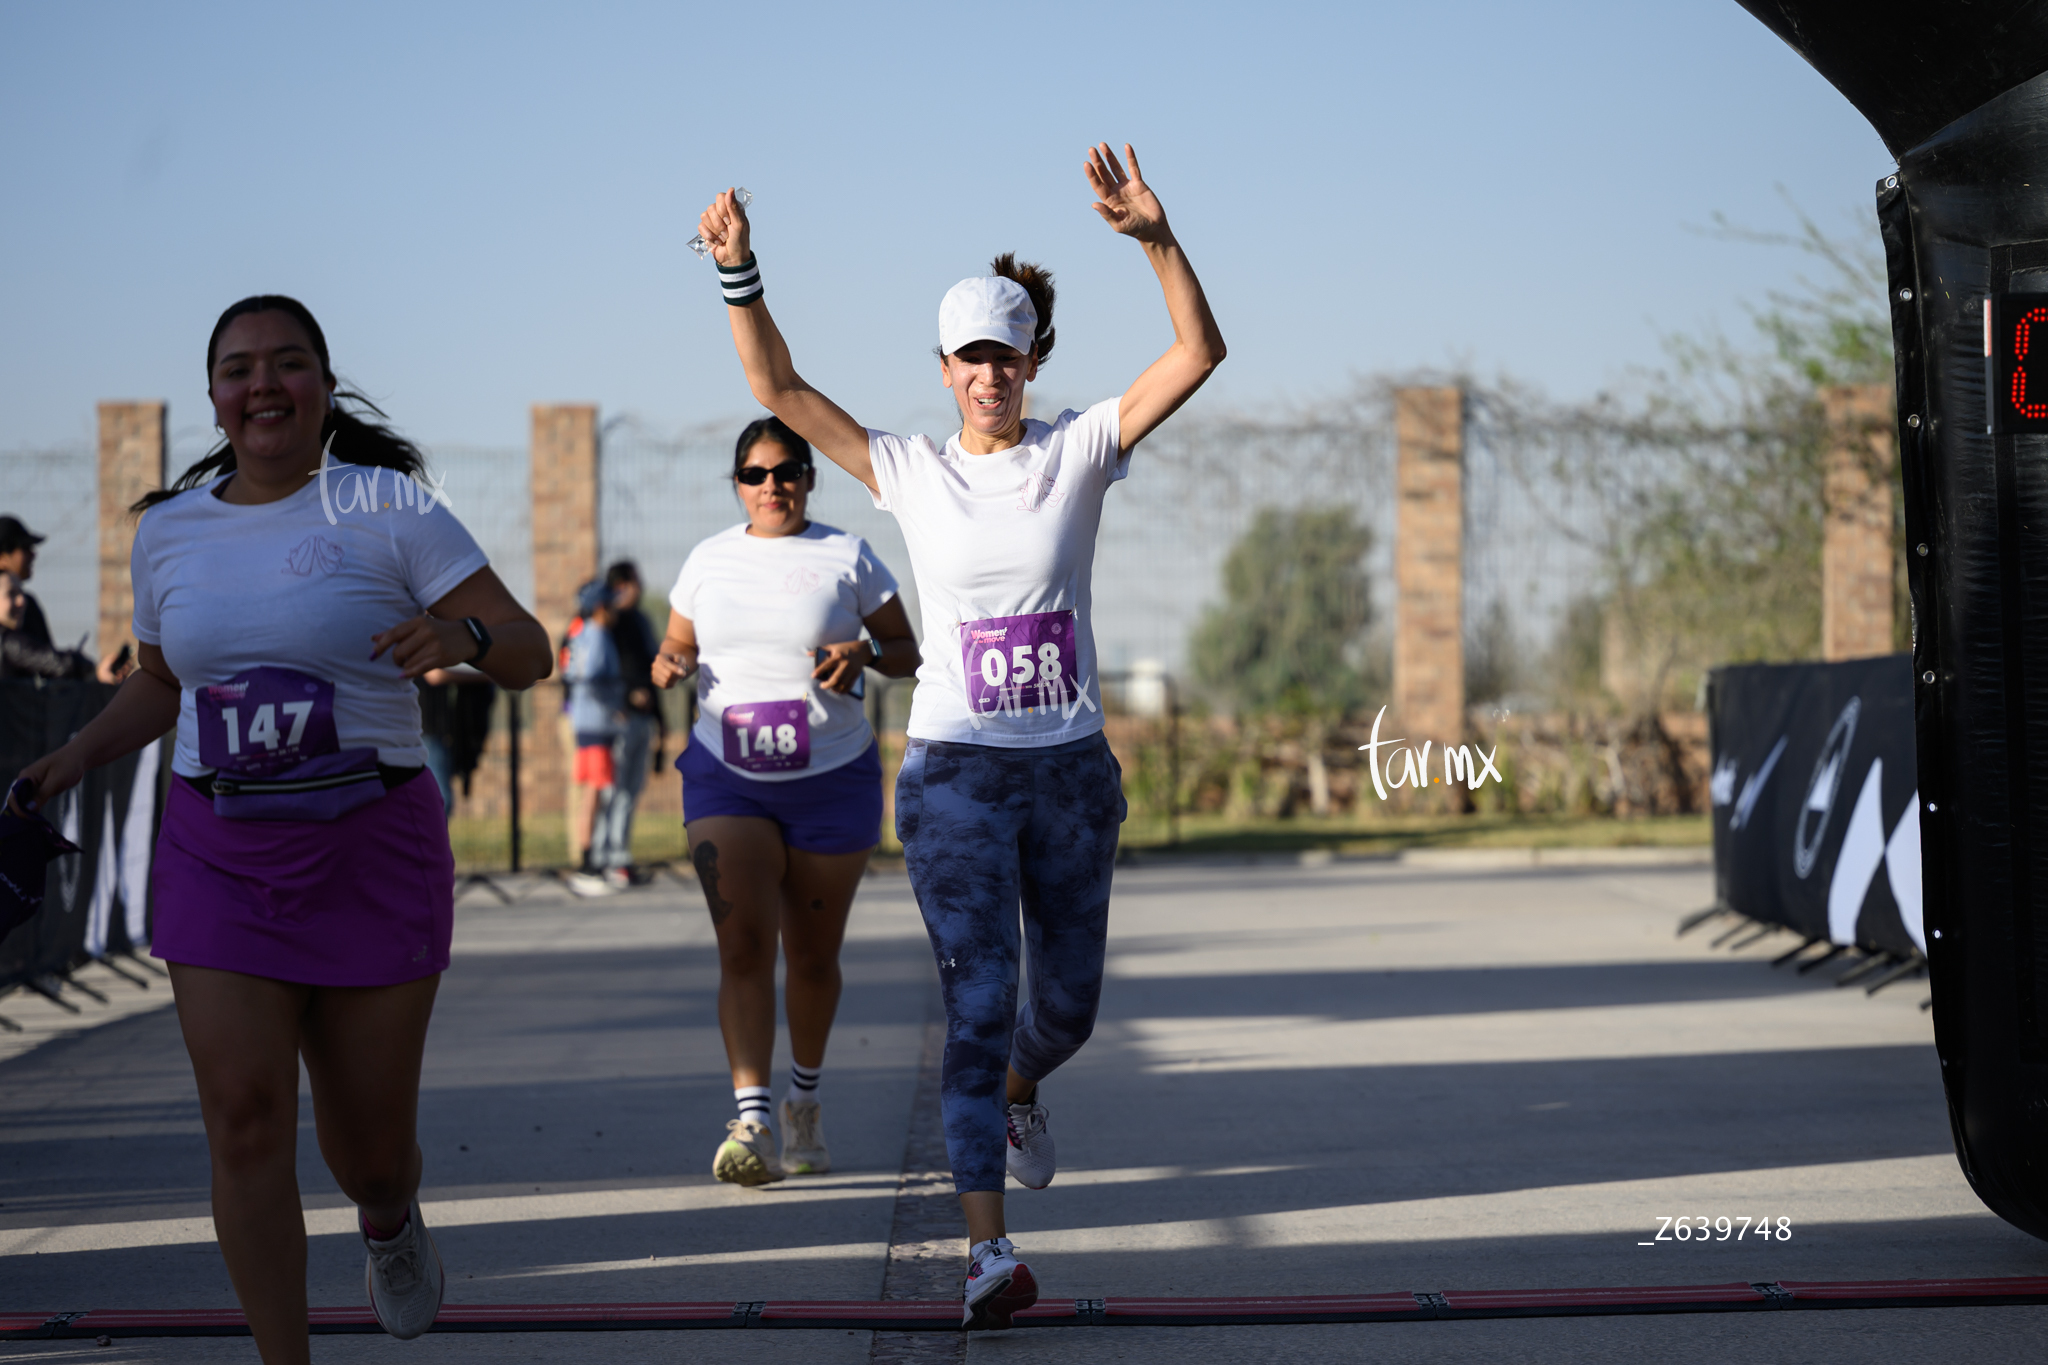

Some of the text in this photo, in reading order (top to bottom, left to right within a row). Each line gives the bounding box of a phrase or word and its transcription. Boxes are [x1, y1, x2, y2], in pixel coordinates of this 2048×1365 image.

[981, 642, 1062, 687] 058
[222, 700, 314, 755] 147
[737, 724, 797, 758] 148
